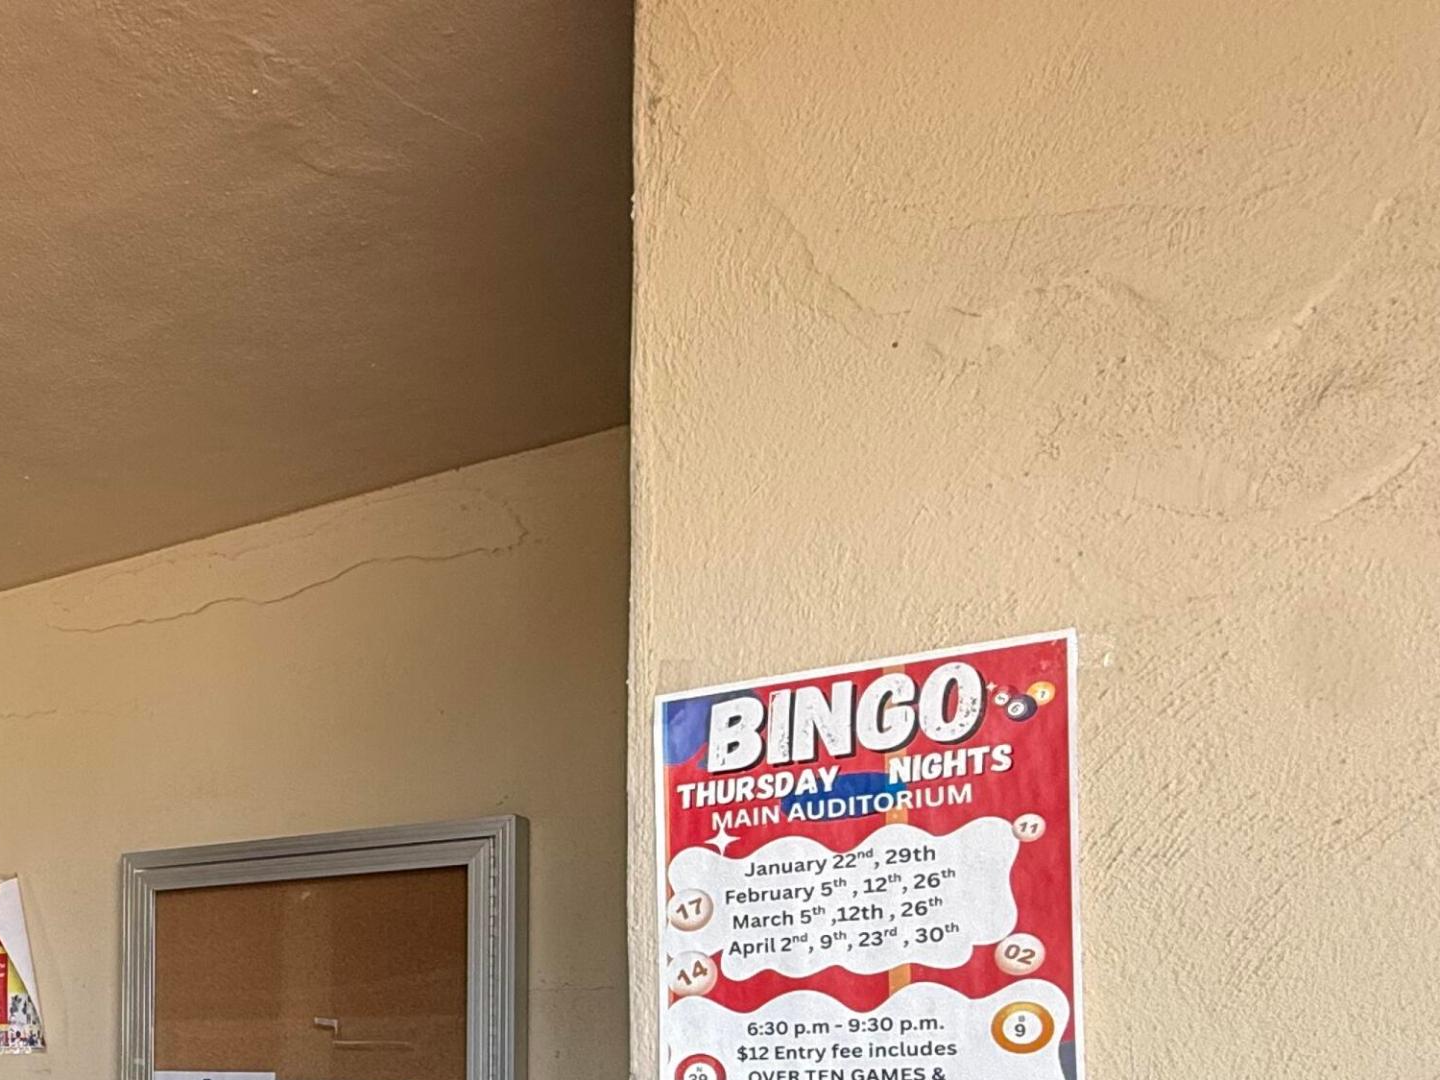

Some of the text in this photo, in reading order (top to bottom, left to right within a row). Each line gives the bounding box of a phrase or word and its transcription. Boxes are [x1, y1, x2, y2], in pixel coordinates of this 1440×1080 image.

[707, 662, 985, 773] BINGO
[677, 744, 1012, 809] THURSDAY NIGHTS
[712, 783, 972, 831] MAIN AUDITORIUM
[1019, 821, 1040, 834] 11
[744, 858, 827, 877] January
[885, 845, 936, 865] 29th
[725, 886, 814, 904] February
[913, 868, 956, 890] 26th
[676, 897, 703, 920] 17
[732, 910, 794, 930] March
[901, 896, 943, 918] 26th
[728, 937, 776, 958] April
[915, 923, 960, 944] 30th
[1004, 943, 1037, 965] 02
[677, 960, 708, 986] 14
[747, 1021, 788, 1036] 6:30
[794, 1021, 830, 1038] p.m
[848, 1017, 893, 1033] 9:30
[900, 1017, 945, 1034] p.m.
[1014, 1024, 1026, 1037] 9
[737, 1041, 957, 1063] $12 Entry fee includes
